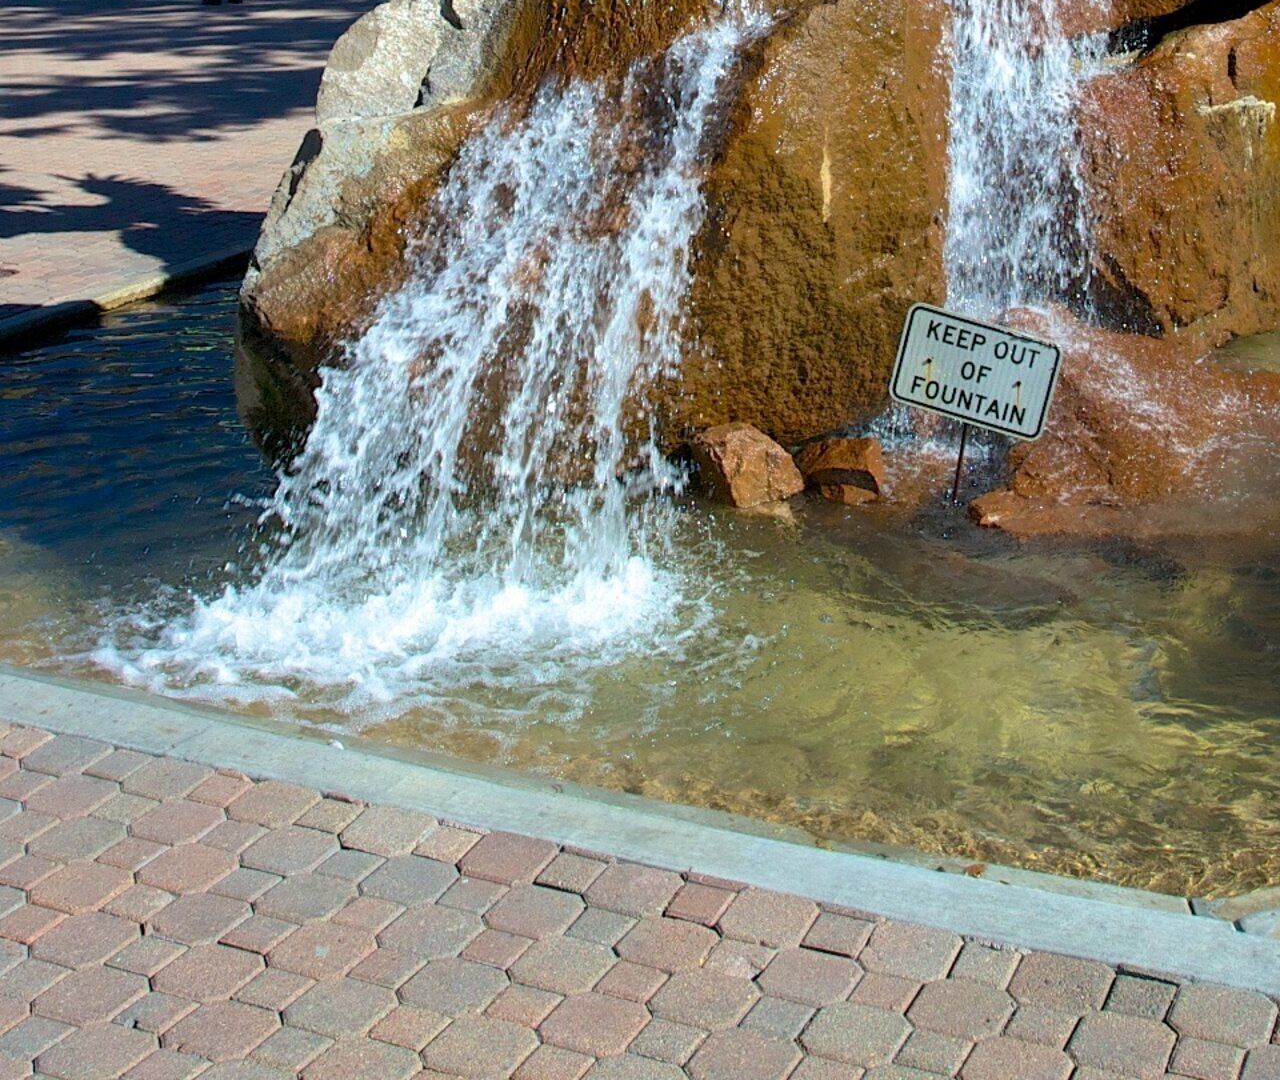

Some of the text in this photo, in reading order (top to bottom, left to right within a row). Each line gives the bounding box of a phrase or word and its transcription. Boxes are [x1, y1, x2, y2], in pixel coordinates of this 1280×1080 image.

[926, 320, 1040, 368] KEEP OUT
[960, 361, 992, 383] OF
[910, 375, 1026, 425] FOUNTAIN
